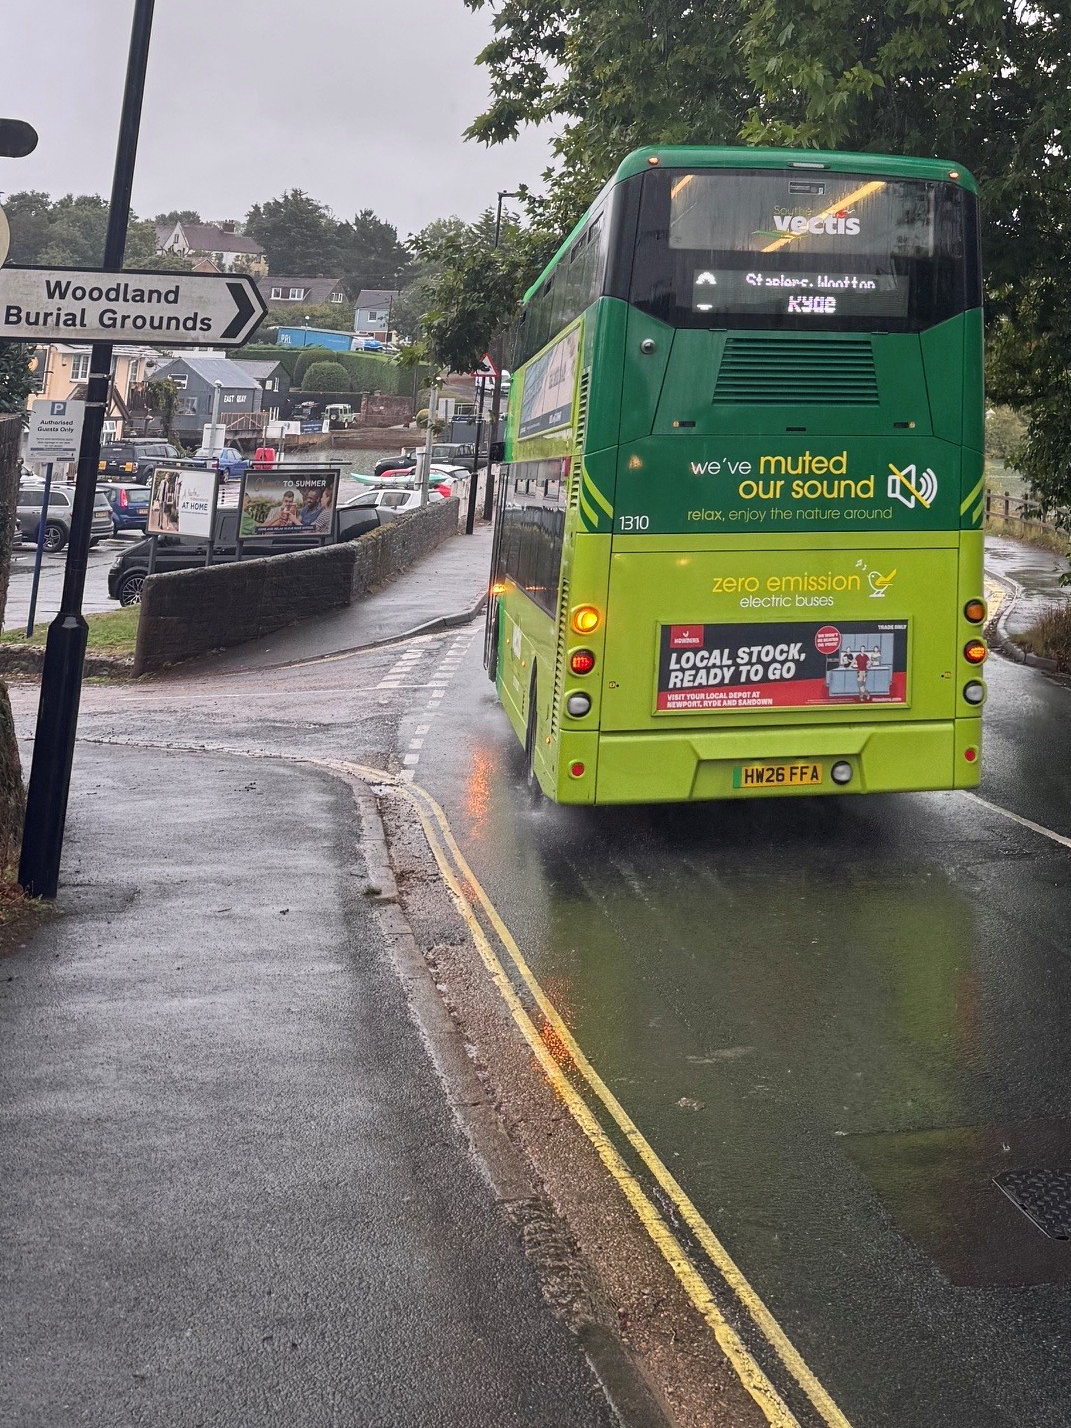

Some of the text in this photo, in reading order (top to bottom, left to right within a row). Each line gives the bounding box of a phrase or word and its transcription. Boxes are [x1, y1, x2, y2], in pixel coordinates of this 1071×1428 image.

[773, 214, 860, 235] vectis
[45, 280, 180, 304] Woodland
[4, 305, 212, 332] Burial Grounds
[690, 451, 847, 475] we've muted
[283, 480, 294, 488] TO
[295, 480, 327, 488] SUMMER
[738, 475, 874, 499] our sound
[190, 502, 208, 511] HOME
[687, 506, 893, 524] relax, enjoy the nature around
[619, 515, 650, 530] 1310
[712, 572, 861, 592] zero emission
[740, 594, 834, 607] electric buses
[669, 642, 807, 670] LOCAL STOCK,
[668, 661, 796, 689] READY TO GO
[667, 693, 685, 701] VISIT
[706, 692, 728, 700] LOCAL
[728, 691, 751, 699] DEPOT
[667, 700, 702, 708] NEWPORT,
[703, 699, 722, 707] RYDE
[738, 698, 773, 706] SANDOWN
[744, 765, 820, 784] HW26 FFA
